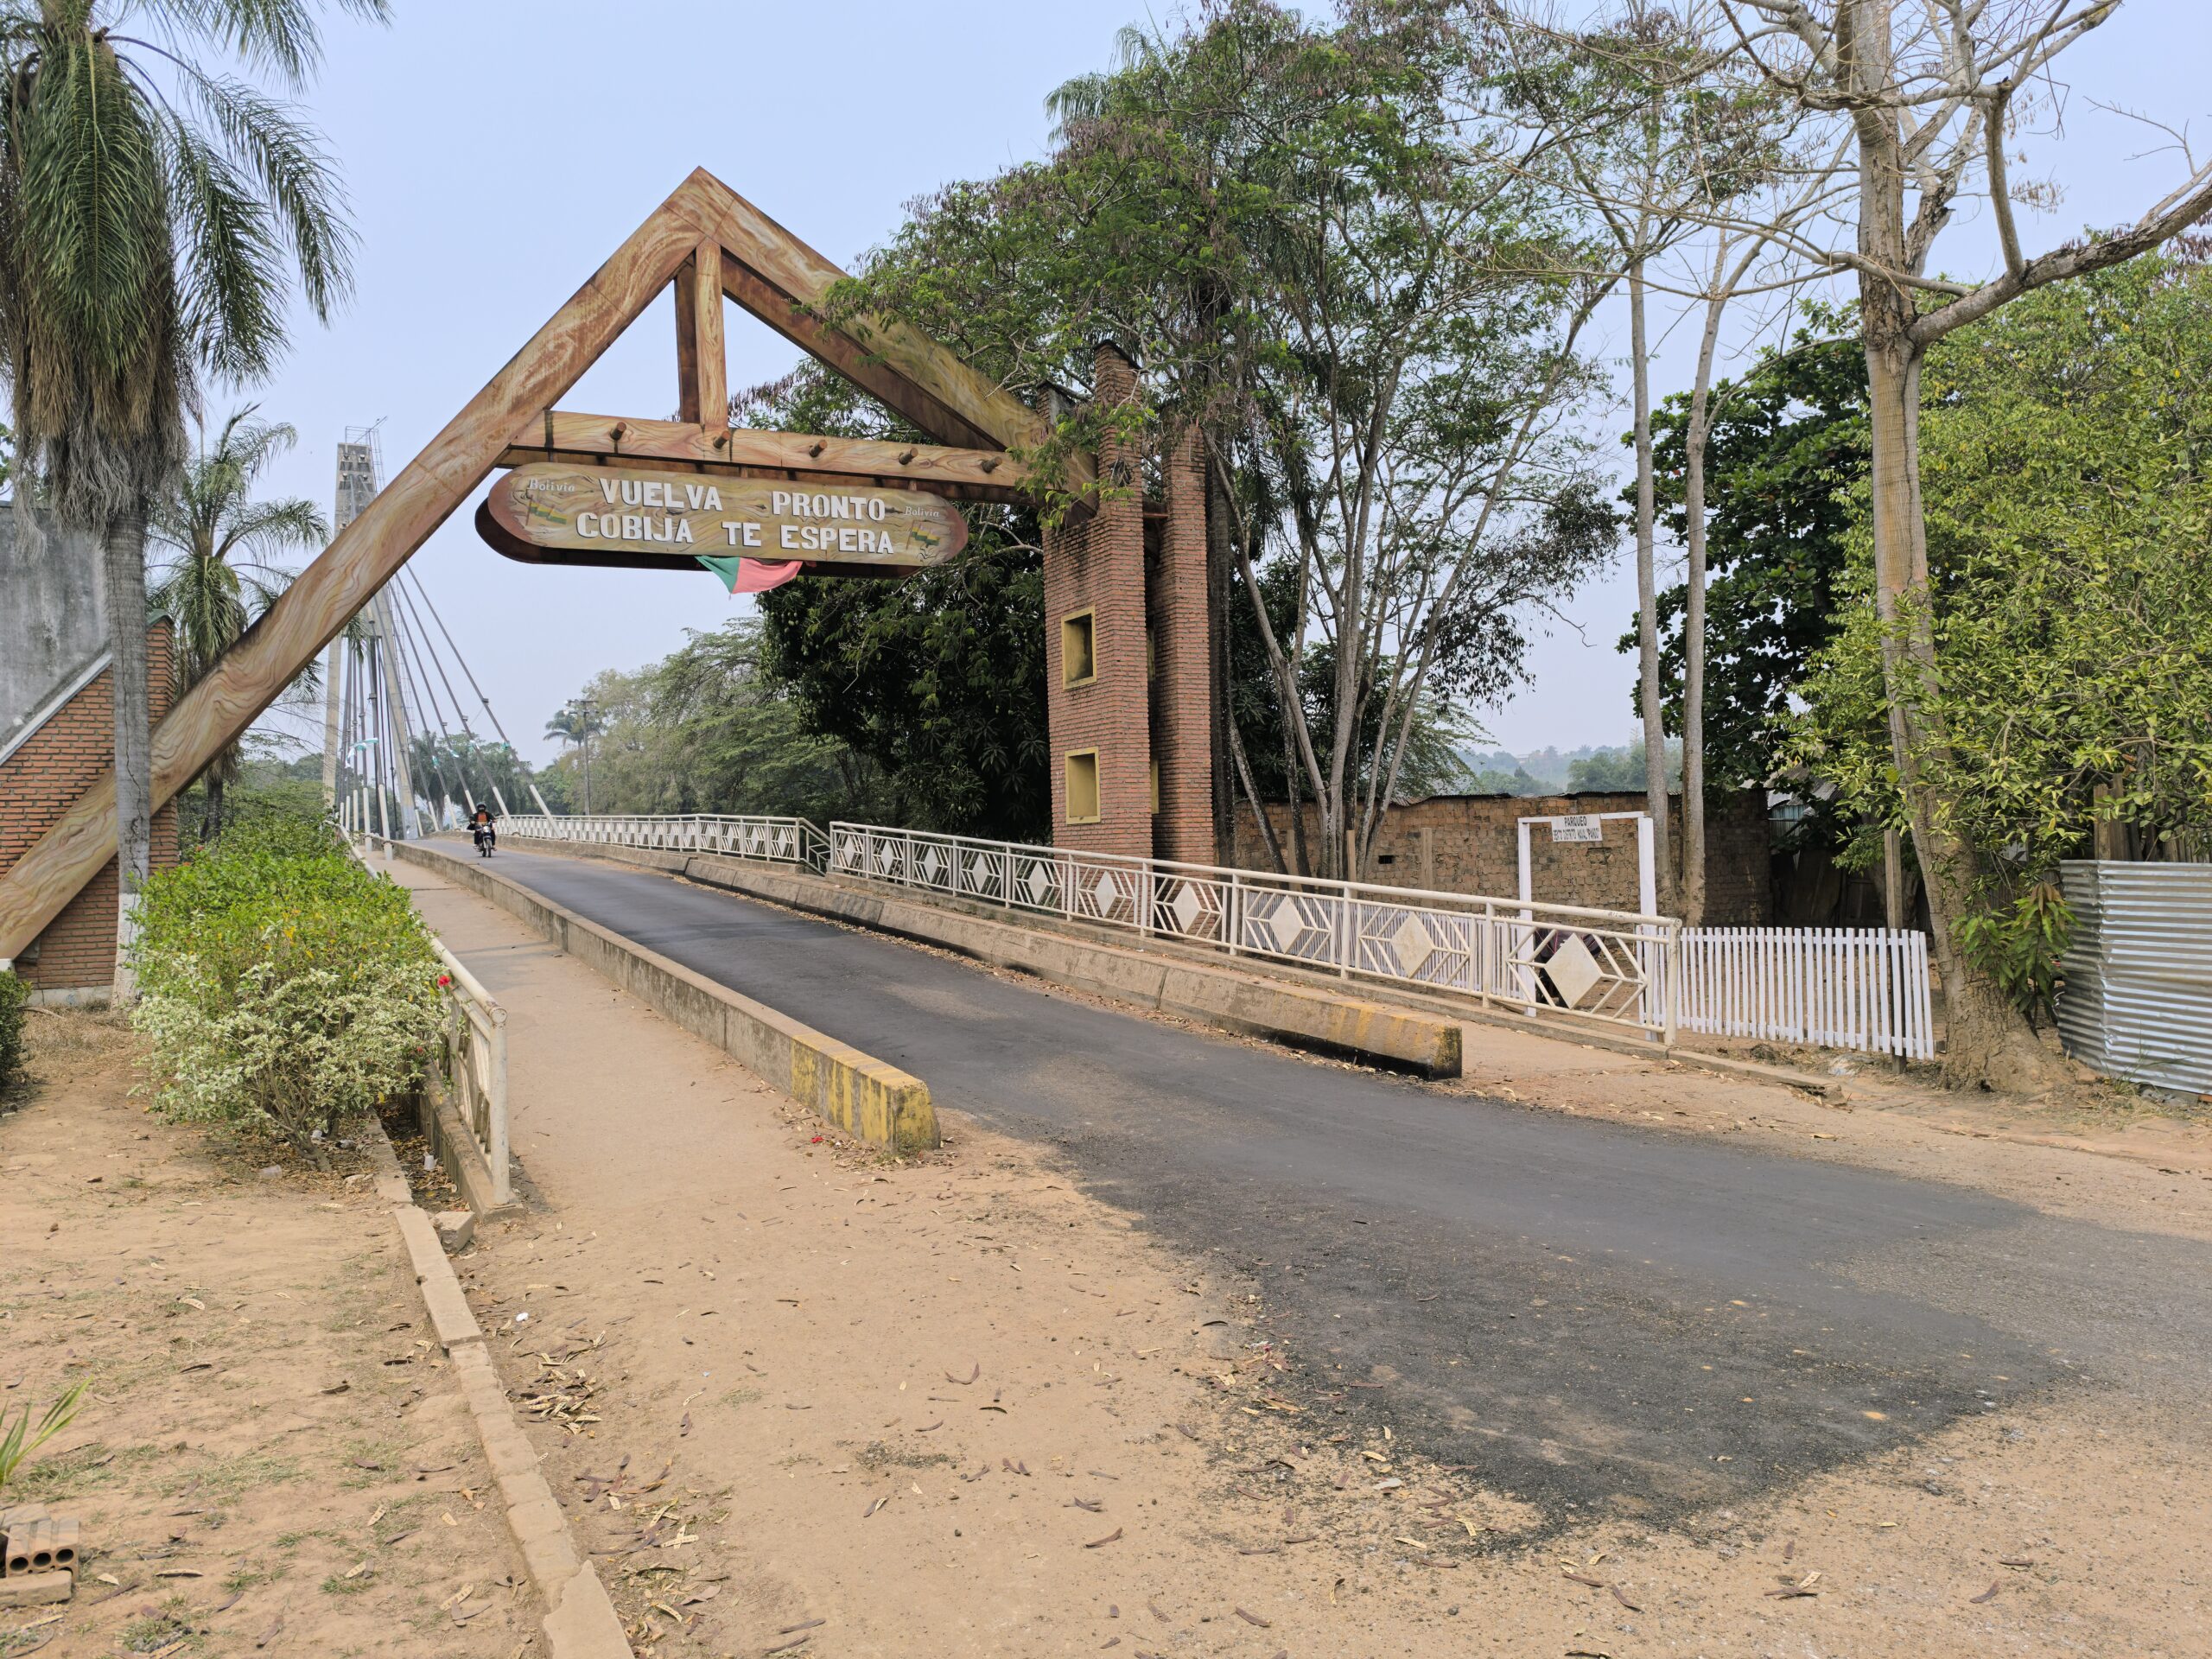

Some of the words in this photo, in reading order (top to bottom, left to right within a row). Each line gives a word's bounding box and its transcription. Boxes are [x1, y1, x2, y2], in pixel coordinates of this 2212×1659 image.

[526, 478, 575, 493] Bolivia
[599, 478, 723, 512] VUELVA
[772, 490, 887, 522] PRONTO
[904, 505, 940, 518] Bolivia
[575, 512, 694, 544] COBIJA
[721, 521, 762, 548] TE
[779, 524, 895, 555] ESPERA
[1564, 816, 1587, 827] PARQUEO
